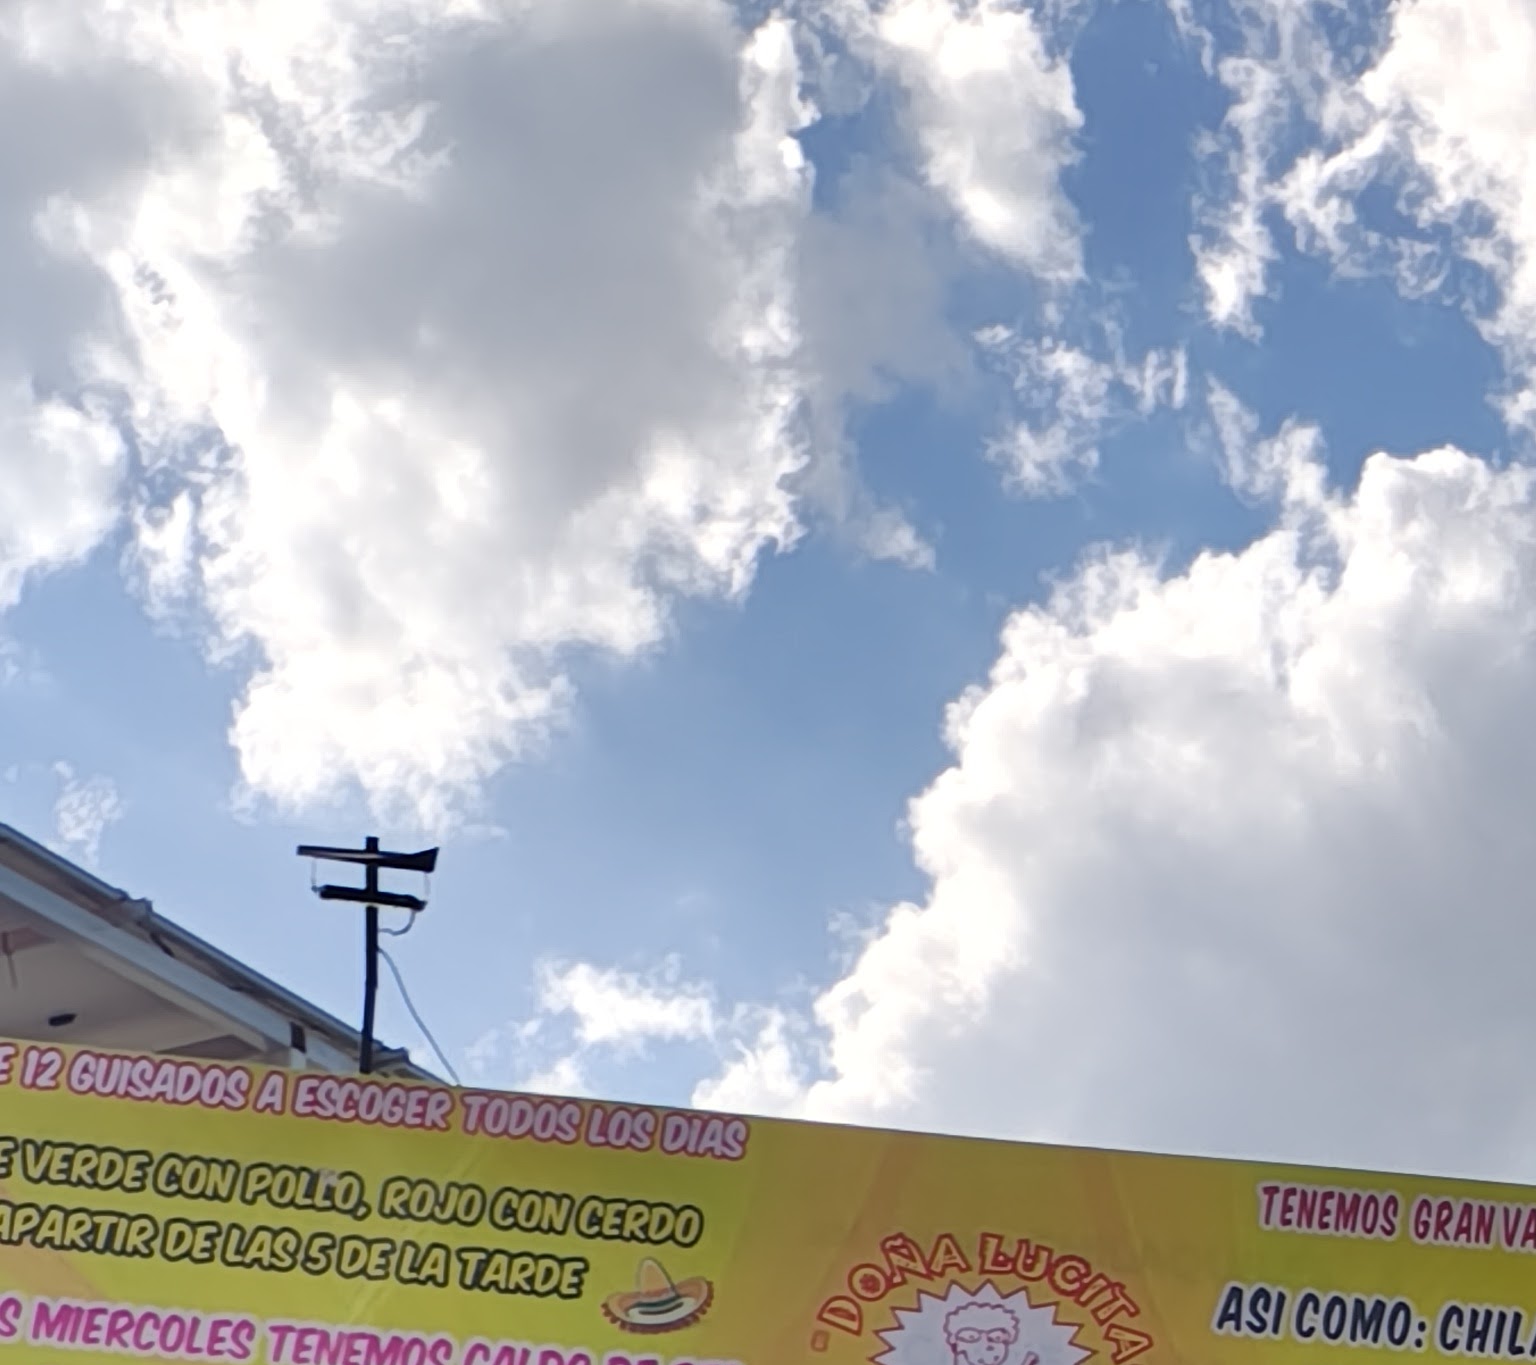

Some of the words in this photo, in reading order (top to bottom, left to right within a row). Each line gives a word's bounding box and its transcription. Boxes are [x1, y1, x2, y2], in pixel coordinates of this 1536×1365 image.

[22, 1049, 63, 1088] 12
[69, 1052, 250, 1110] GUISADOS
[255, 1071, 286, 1114] A
[294, 1075, 453, 1130] ESCOGER
[461, 1093, 582, 1143] TODOS
[586, 1105, 656, 1151] LOS
[661, 1114, 748, 1159] DIAS
[21, 1139, 152, 1192] VERDE
[154, 1153, 239, 1200] CON
[242, 1163, 371, 1220] POLLO,
[380, 1176, 485, 1226] ROJO
[489, 1187, 575, 1234] CON
[576, 1196, 704, 1248] CERDO
[1262, 1185, 1399, 1237] TENEMOS
[1413, 1198, 1495, 1245] GRAN
[163, 1218, 221, 1263] DE
[222, 1223, 300, 1272] LAS
[302, 1233, 336, 1275] 5
[337, 1235, 396, 1280] DE
[397, 1240, 449, 1287] LA
[457, 1247, 589, 1299] TARDE
[32, 1301, 256, 1359] MIERCOLES
[1216, 1285, 1287, 1335] ASI
[1294, 1292, 1427, 1348] COMO:
